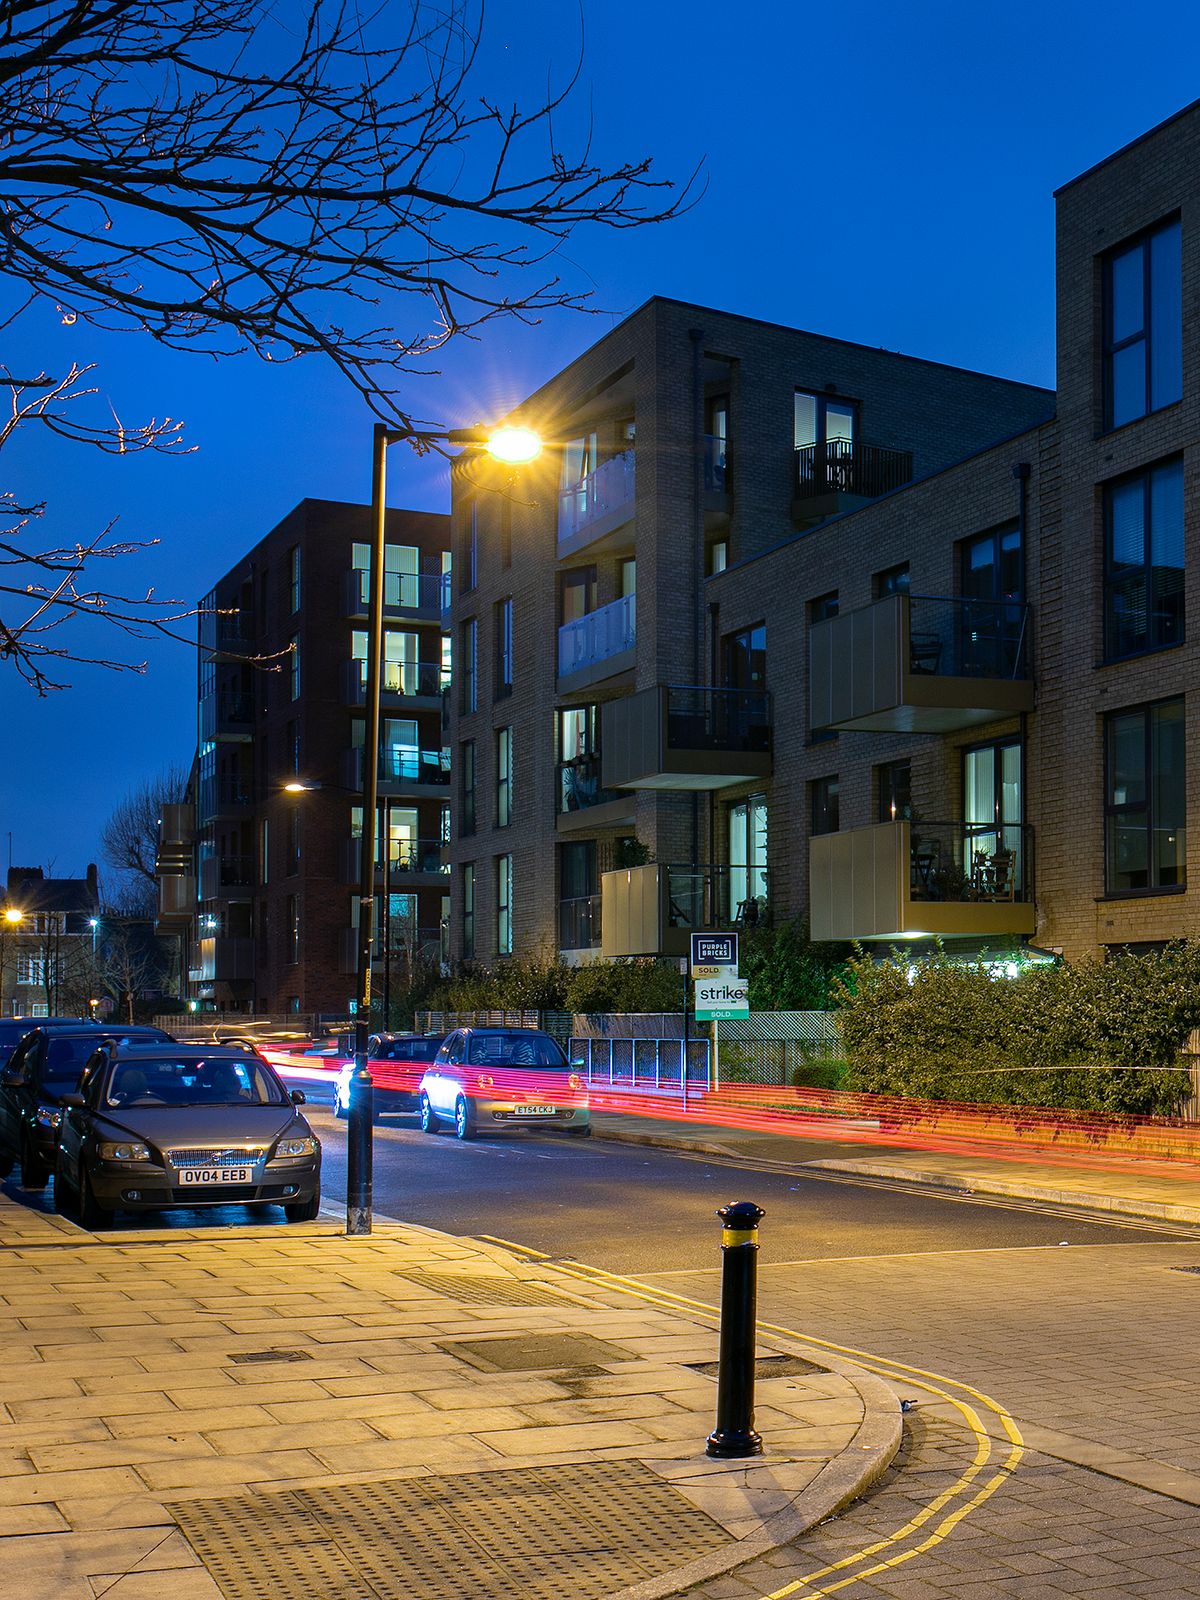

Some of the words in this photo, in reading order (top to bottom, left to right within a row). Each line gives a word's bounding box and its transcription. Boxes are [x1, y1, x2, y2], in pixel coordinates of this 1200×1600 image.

[700, 985, 744, 1000] strike
[185, 1170, 218, 1182] OV04
[222, 1169, 247, 1181] EEB
